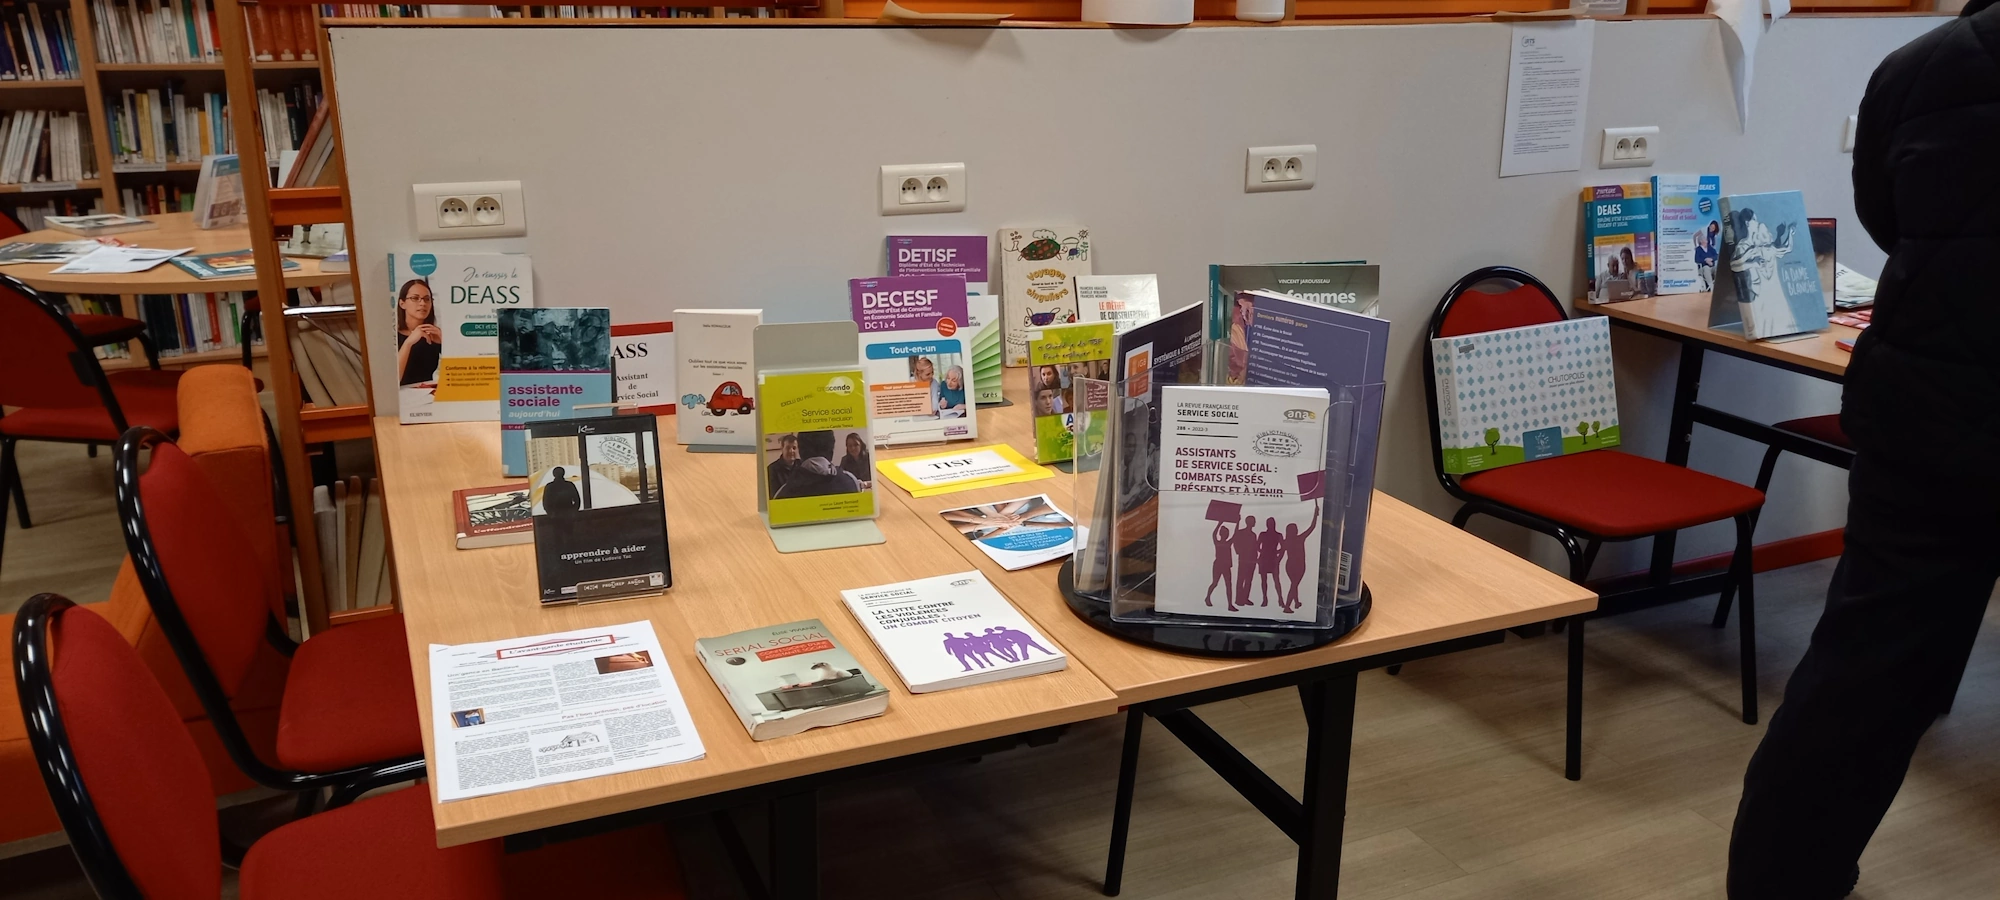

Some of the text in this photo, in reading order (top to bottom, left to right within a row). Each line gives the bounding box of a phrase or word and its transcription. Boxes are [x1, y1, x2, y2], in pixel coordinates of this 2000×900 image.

[1597, 204, 1622, 216] DEAES
[898, 248, 957, 262] DETISF
[1781, 267, 1809, 281] LA DAME
[451, 285, 520, 304] DEASS
[1786, 280, 1817, 297] BLANCHE
[861, 290, 938, 309] DECESF
[1099, 301, 1105, 311] LE
[1099, 311, 1107, 321] DE
[1256, 312, 1309, 329] Derniers numéros parus
[864, 321, 878, 330] DC
[889, 320, 896, 329] 4
[889, 344, 937, 354] Tout-en-un
[1547, 371, 1585, 385] CHUTOPOLIS
[508, 384, 584, 395] assistante
[628, 383, 638, 391] de
[636, 390, 660, 400] Social
[508, 396, 561, 407] sociale
[781, 397, 797, 408] EXCLU
[1202, 403, 1231, 411] FRANÇAISE
[508, 409, 561, 420] aujourd'hui
[801, 406, 853, 418] Service social
[1177, 409, 1239, 419] SERVICE SOCIAL
[1287, 410, 1316, 420] anas
[1175, 446, 1237, 459] ASSISTANTS
[927, 458, 974, 470] TISF
[1175, 459, 1190, 469] DE
[1191, 460, 1233, 471] SERVICE
[1236, 462, 1272, 473] SOCIAL
[1174, 471, 1267, 486] COMBATS PASSÉS,
[1174, 482, 1227, 495] PRÉSENTS
[561, 544, 646, 562] apprendre à aider
[860, 590, 915, 601] SERVICE SOCIAL
[886, 604, 916, 613] LUTTE
[917, 600, 956, 610] CONTRE
[875, 607, 949, 621] LES VIOLENCES
[879, 613, 941, 625] CONJUGALES
[899, 617, 938, 628] COMBAT
[941, 612, 982, 623] CITOYEN
[713, 631, 829, 657] SERIAL SOCIAL
